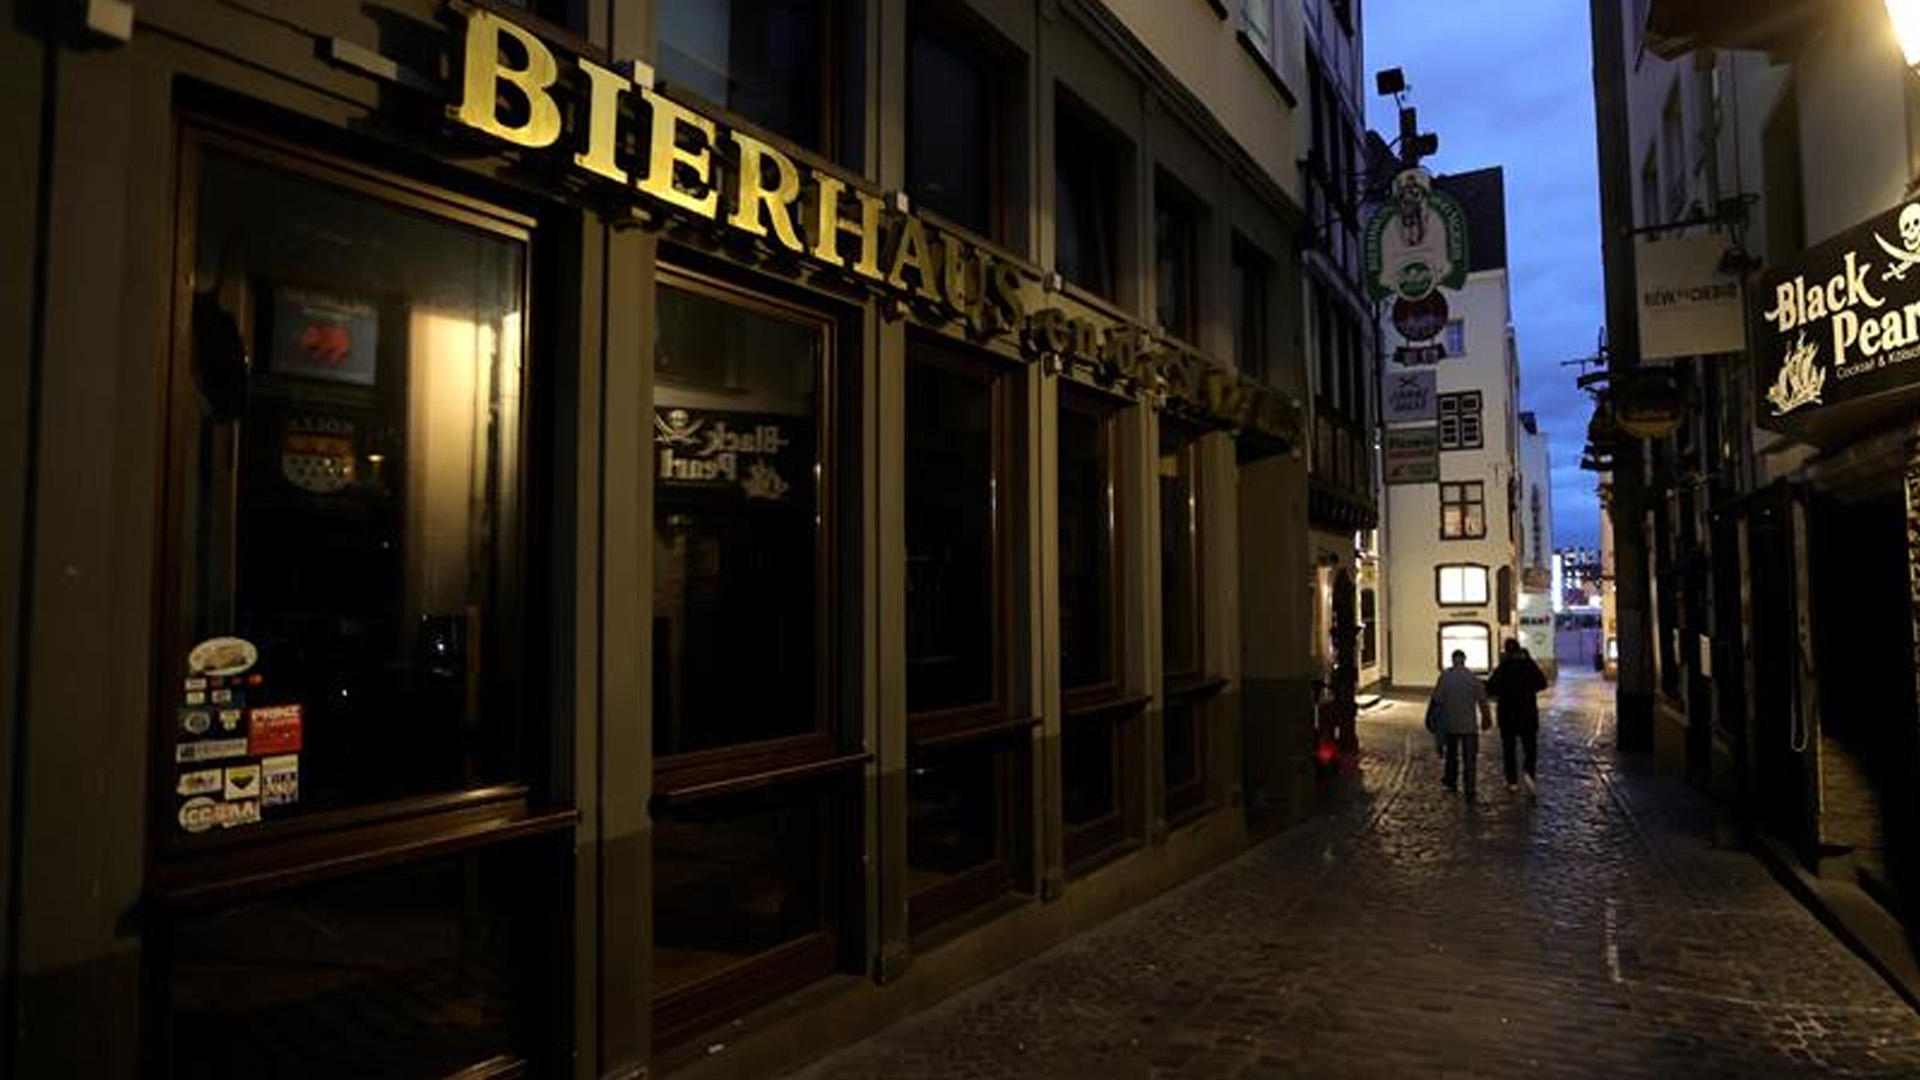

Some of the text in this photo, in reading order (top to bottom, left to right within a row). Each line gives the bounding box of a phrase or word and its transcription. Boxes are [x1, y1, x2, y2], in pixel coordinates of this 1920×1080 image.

[446, 10, 1024, 330] BIERHAUS
[1764, 251, 1886, 333] Black
[1877, 354, 1887, 368] &
